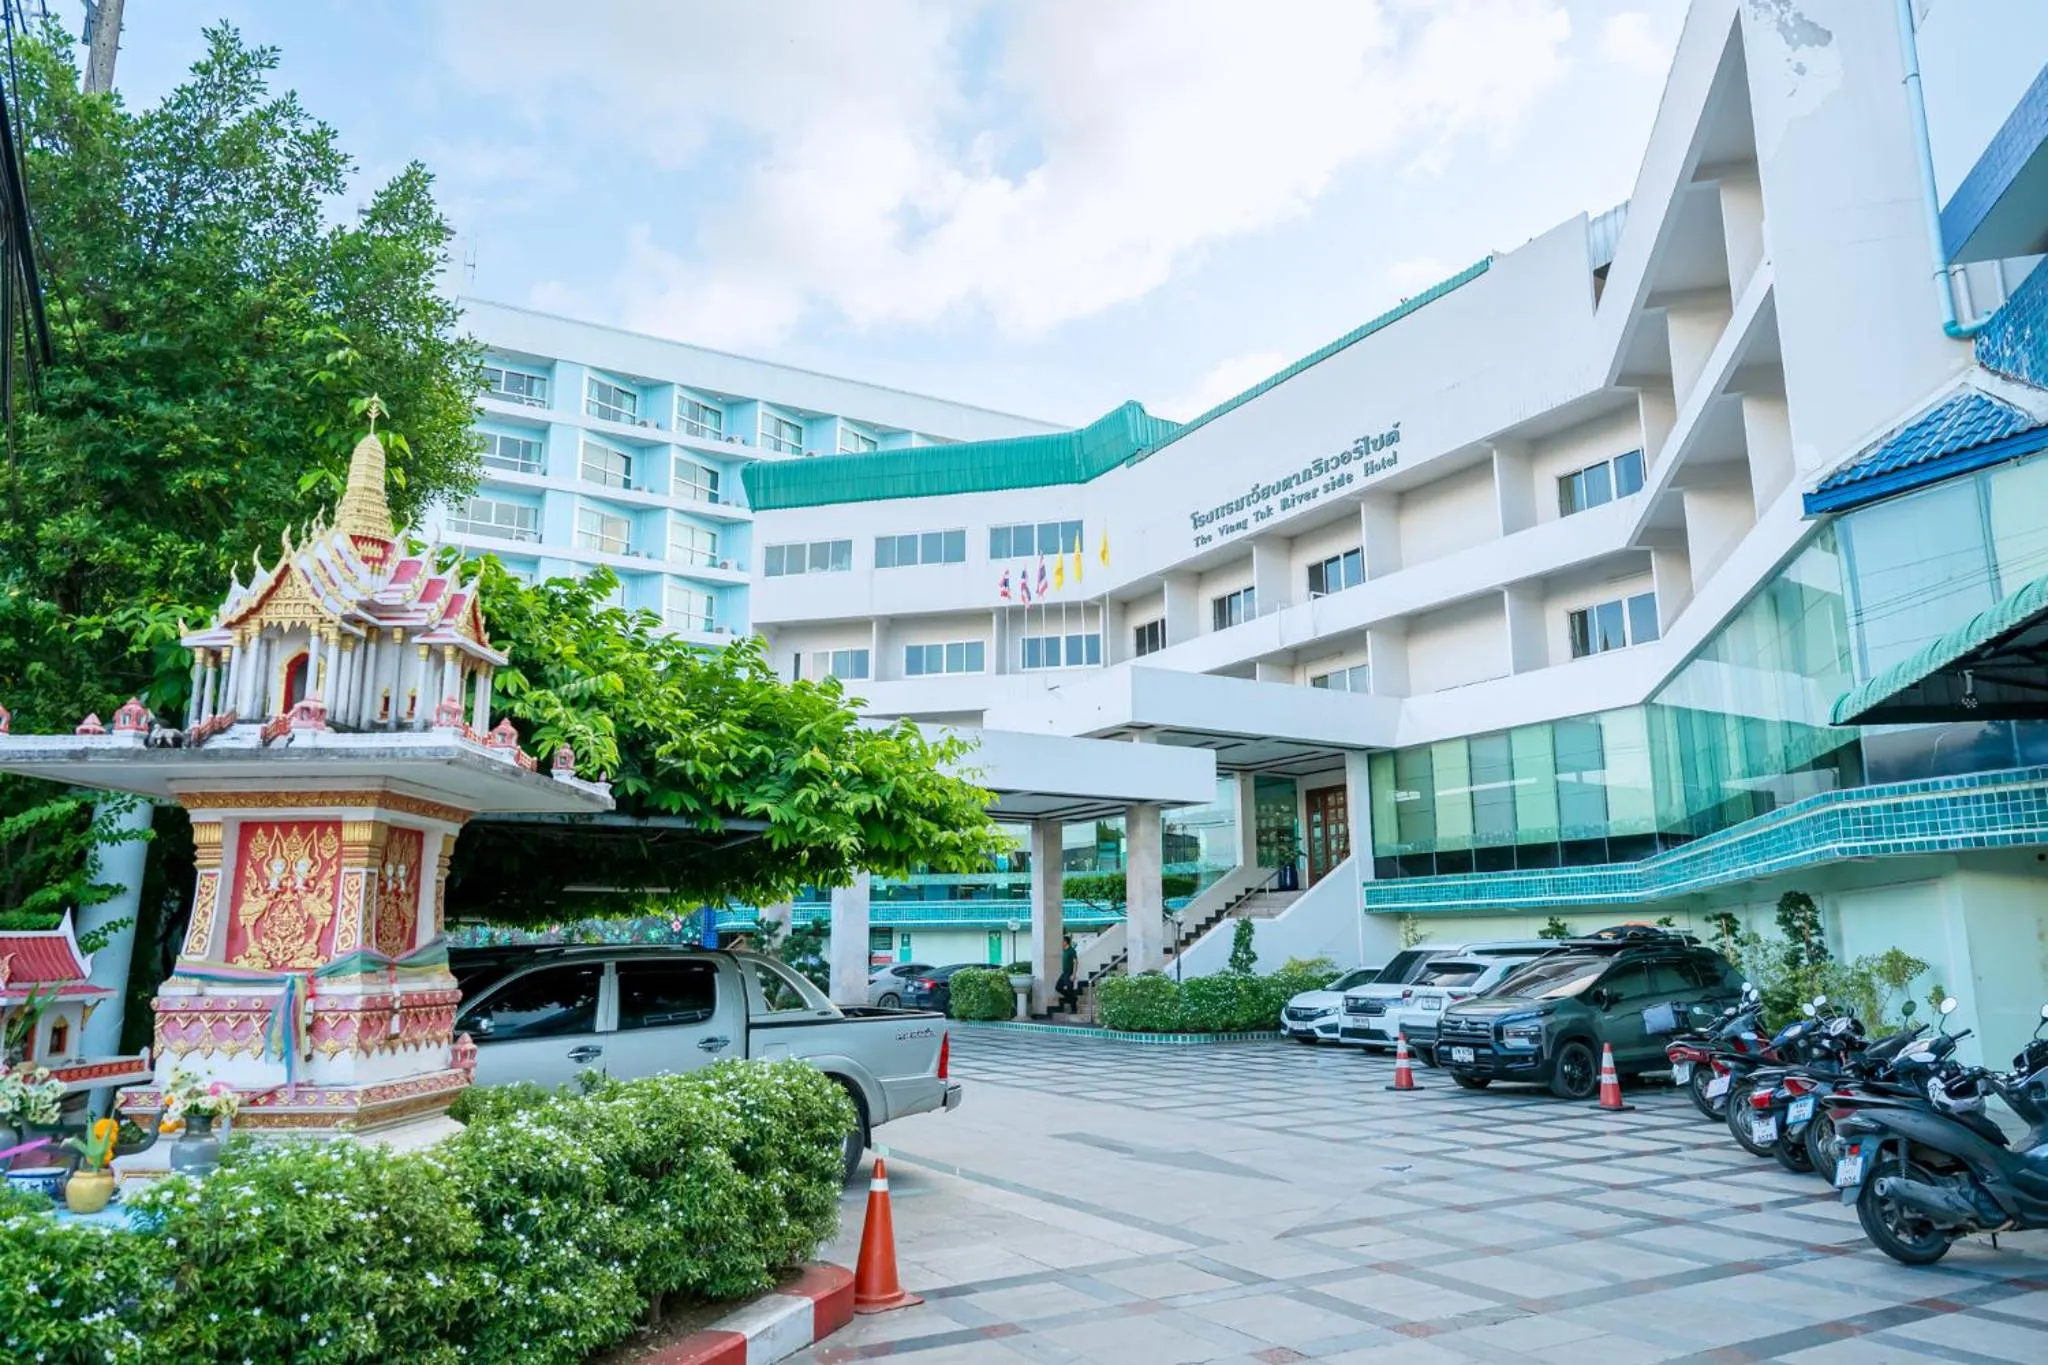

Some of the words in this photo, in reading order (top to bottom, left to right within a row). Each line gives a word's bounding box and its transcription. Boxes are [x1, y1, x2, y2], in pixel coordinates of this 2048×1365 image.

[1193, 534, 1212, 548] The
[1218, 518, 1248, 536] Viang
[1253, 505, 1274, 522] Tak
[1280, 487, 1319, 511] River
[1323, 473, 1354, 493] side
[1363, 450, 1398, 477] Hotel
